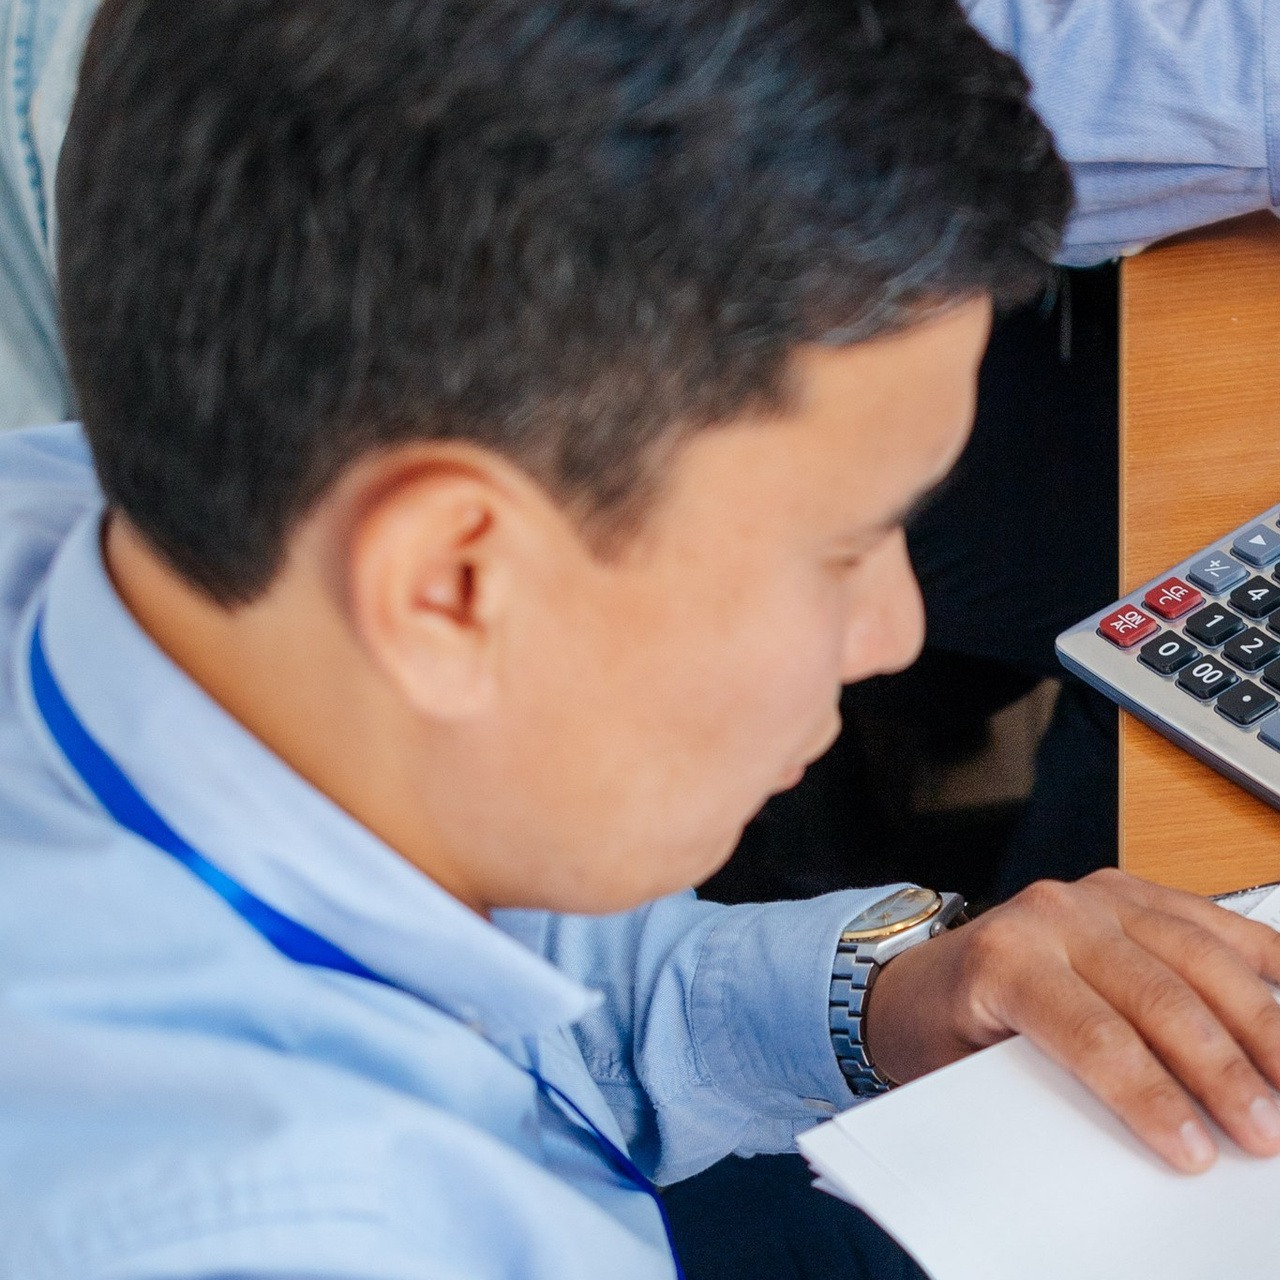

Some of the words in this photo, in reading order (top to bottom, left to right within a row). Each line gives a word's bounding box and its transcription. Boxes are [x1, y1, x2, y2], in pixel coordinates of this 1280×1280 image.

[1169, 585, 1189, 599] CE
[1247, 588, 1270, 601] 4
[1159, 595, 1173, 606] C
[1124, 610, 1146, 625] ON
[1205, 614, 1225, 628] 1
[1110, 620, 1133, 634] AC
[1158, 641, 1180, 657] 0
[1240, 637, 1264, 654] 2
[1192, 662, 1223, 683] 00
